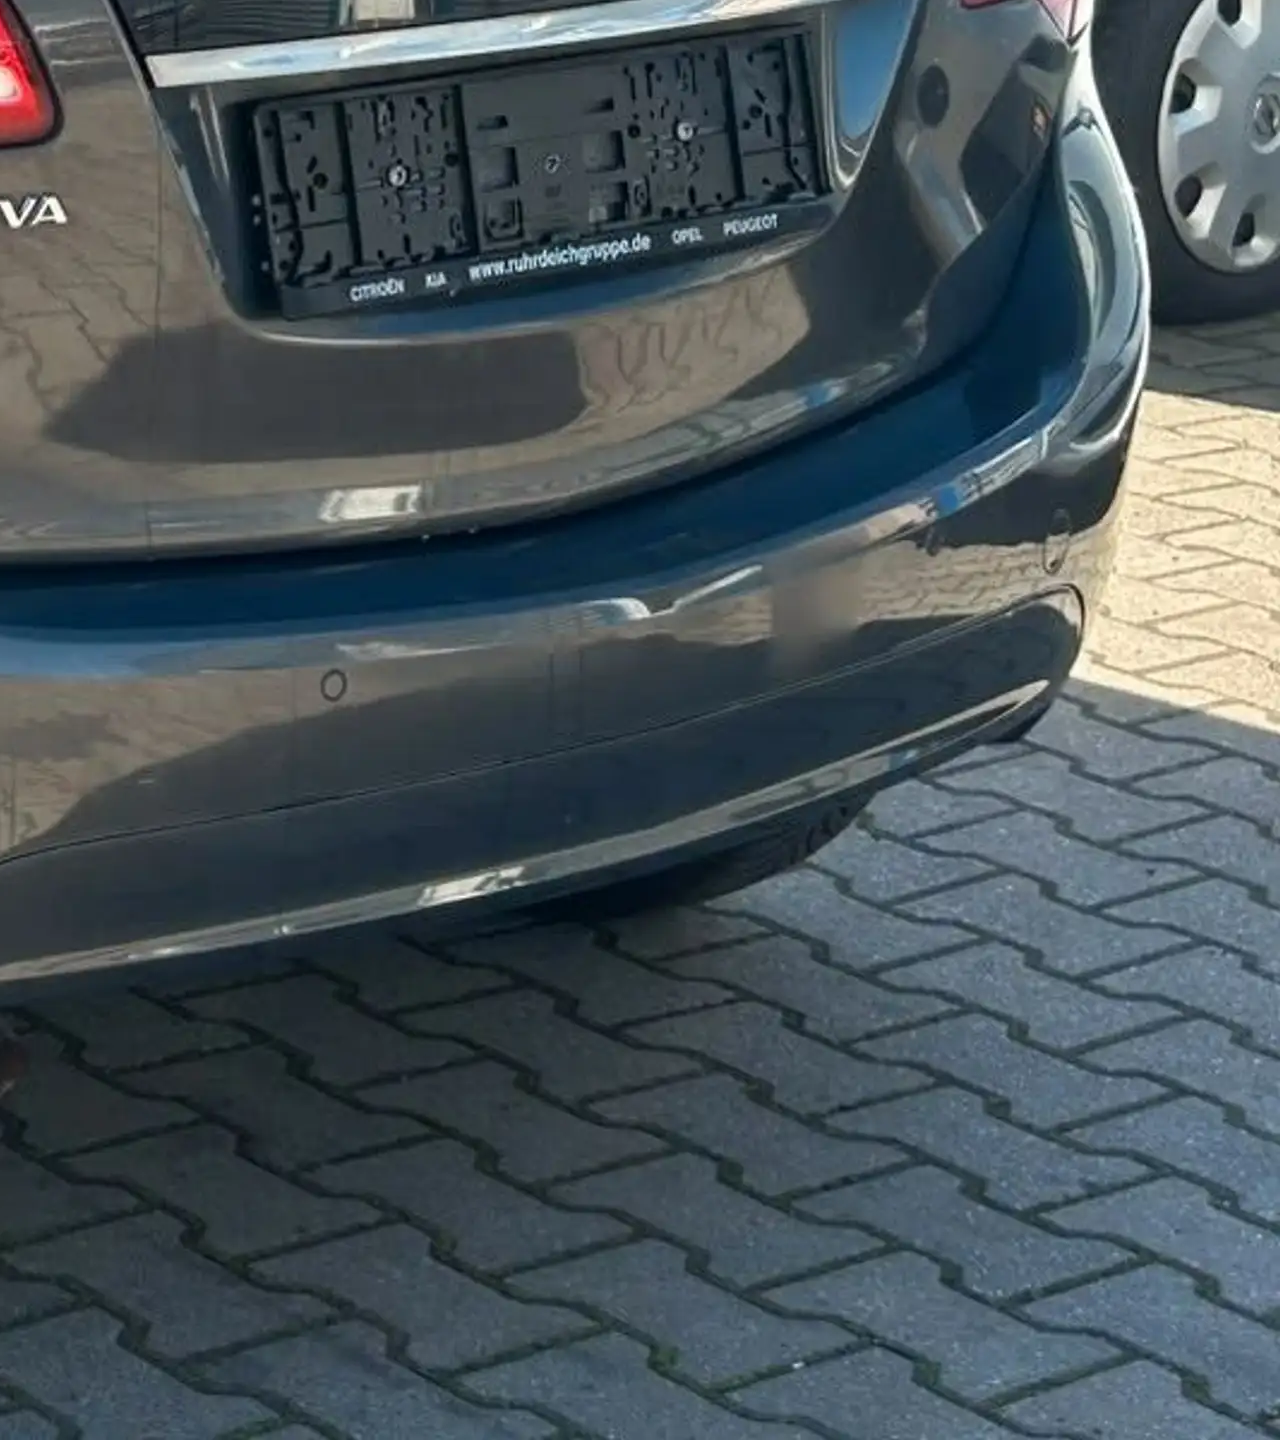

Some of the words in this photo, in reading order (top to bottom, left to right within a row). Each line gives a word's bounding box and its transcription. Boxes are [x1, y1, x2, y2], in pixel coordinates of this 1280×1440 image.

[425, 271, 448, 289] KIA
[468, 232, 653, 282] www.ruhrdeichgruppe.de
[671, 227, 704, 246] OPEL
[722, 213, 779, 237] PEUGEOT
